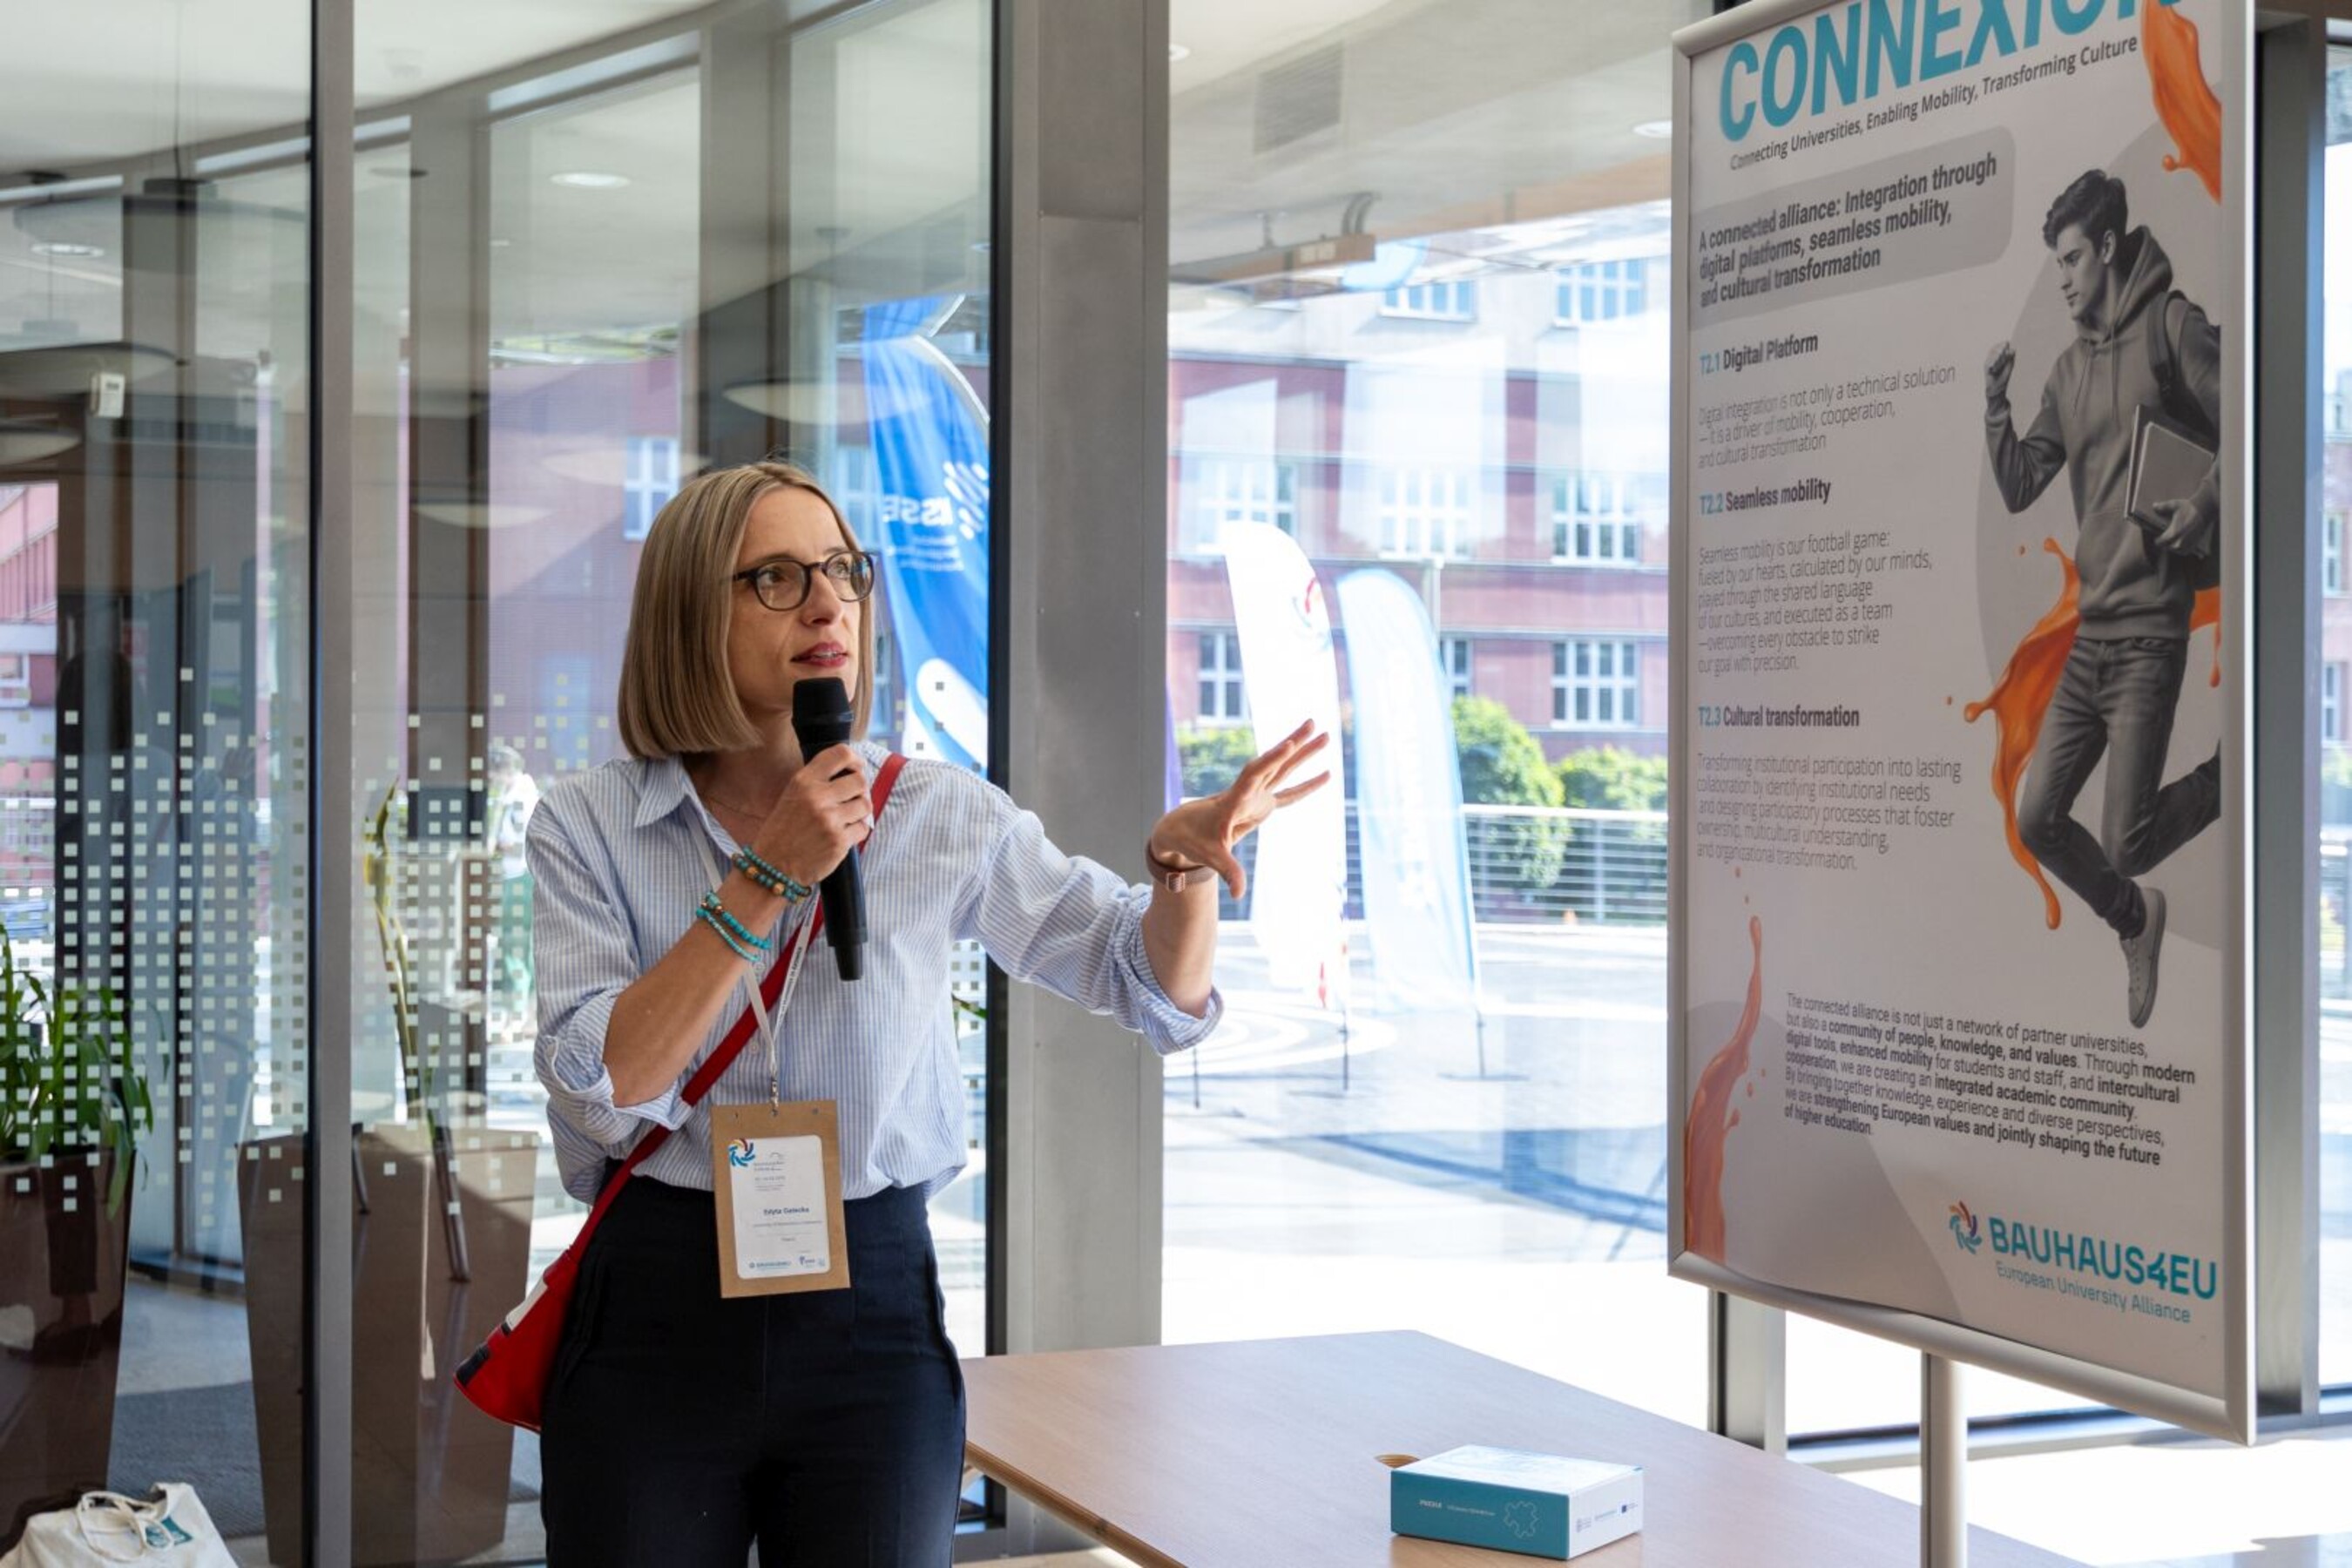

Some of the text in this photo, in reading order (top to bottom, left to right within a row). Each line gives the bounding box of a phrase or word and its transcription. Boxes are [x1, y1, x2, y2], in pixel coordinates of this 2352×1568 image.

[1730, 35, 2138, 170] Connecting Universities, Enabling Mobility, Transforming Culture
[1699, 150, 1997, 251] A connected alliance: Integration through
[1700, 199, 1951, 281] digital platforms, seamless mobility,
[1720, 268, 1771, 301] cultural
[1774, 246, 1880, 288] transformation
[1700, 335, 1818, 375] T2.1 Digital Platform
[1790, 363, 1956, 409] not only a technical solution
[1821, 400, 1896, 429] cooperation,
[1700, 477, 1831, 515] T2.2 Seamless mobility
[1788, 540, 1805, 555] our
[1808, 531, 1850, 553] football
[1853, 531, 1889, 555] game:
[1790, 556, 1845, 578] calculated
[1848, 555, 1862, 578] by
[1865, 557, 1885, 572] our
[1889, 549, 1932, 571] minds,
[1782, 581, 1817, 601] shared
[1821, 580, 1872, 603] language
[1764, 607, 1781, 625] and
[1784, 605, 1832, 624] executed
[1835, 607, 1848, 621] as
[1851, 606, 1858, 620] a
[1862, 605, 1892, 620] team
[1758, 633, 1783, 652] every
[1786, 627, 1829, 646] obstacle
[1832, 629, 1844, 645] to
[1848, 625, 1879, 645] strike
[1699, 706, 1859, 726] T2.3 Cultural transformation
[1813, 755, 1883, 780] participation
[1888, 756, 1913, 776] into
[1917, 757, 1961, 784] lasting
[1819, 778, 1887, 800] institutional
[1889, 781, 1930, 801] needs
[1823, 806, 1881, 826] processes
[1885, 805, 1909, 825] that
[1915, 806, 1955, 828] foster
[1788, 992, 2148, 1059] The connected alliance is not just a network of partner universities,
[1829, 1021, 1882, 1044] community
[1885, 1026, 1896, 1042] of
[1898, 1031, 1937, 1051] people,
[1940, 1033, 2005, 1060] knowledge,
[2010, 1044, 2031, 1061] and
[2036, 1048, 2079, 1068] values.
[2142, 1064, 2195, 1085] modern
[1841, 1039, 1887, 1060] enhanced
[1890, 1048, 1932, 1071] mobility
[1936, 1052, 1951, 1070] for
[1954, 1058, 2004, 1078] students
[2008, 1064, 2031, 1082] and
[2034, 1069, 2066, 1090] staff,
[2070, 1074, 2093, 1091] and
[2098, 1076, 2180, 1104] intercultural
[1841, 1060, 1854, 1073] we
[1856, 1063, 1871, 1076] are
[1874, 1065, 1915, 1088] creating
[1919, 1073, 1932, 1086] an
[1935, 1071, 1993, 1097] integrated
[1997, 1085, 2057, 1106] academic
[1815, 1092, 1879, 1120] strengthening
[1882, 1101, 1930, 1126] European
[1933, 1113, 1970, 1132] values
[1973, 1120, 1995, 1137] and
[1997, 1124, 2036, 1149] jointly
[2039, 1131, 2090, 1159] shaping
[2094, 1139, 2115, 1158] the
[2119, 1143, 2160, 1166] future
[1825, 1112, 1871, 1134] education
[1835, 1076, 1874, 1096] together
[1876, 1081, 1934, 1109] knowledge,
[1937, 1096, 1998, 1118] experience
[2002, 1105, 2024, 1122] and
[2028, 1107, 2073, 1130] diverse
[2077, 1119, 2164, 1148] perspectives,
[1989, 1217, 2216, 1300] BAUHAUS4EU
[1997, 1260, 2191, 1323] European University Alliance
